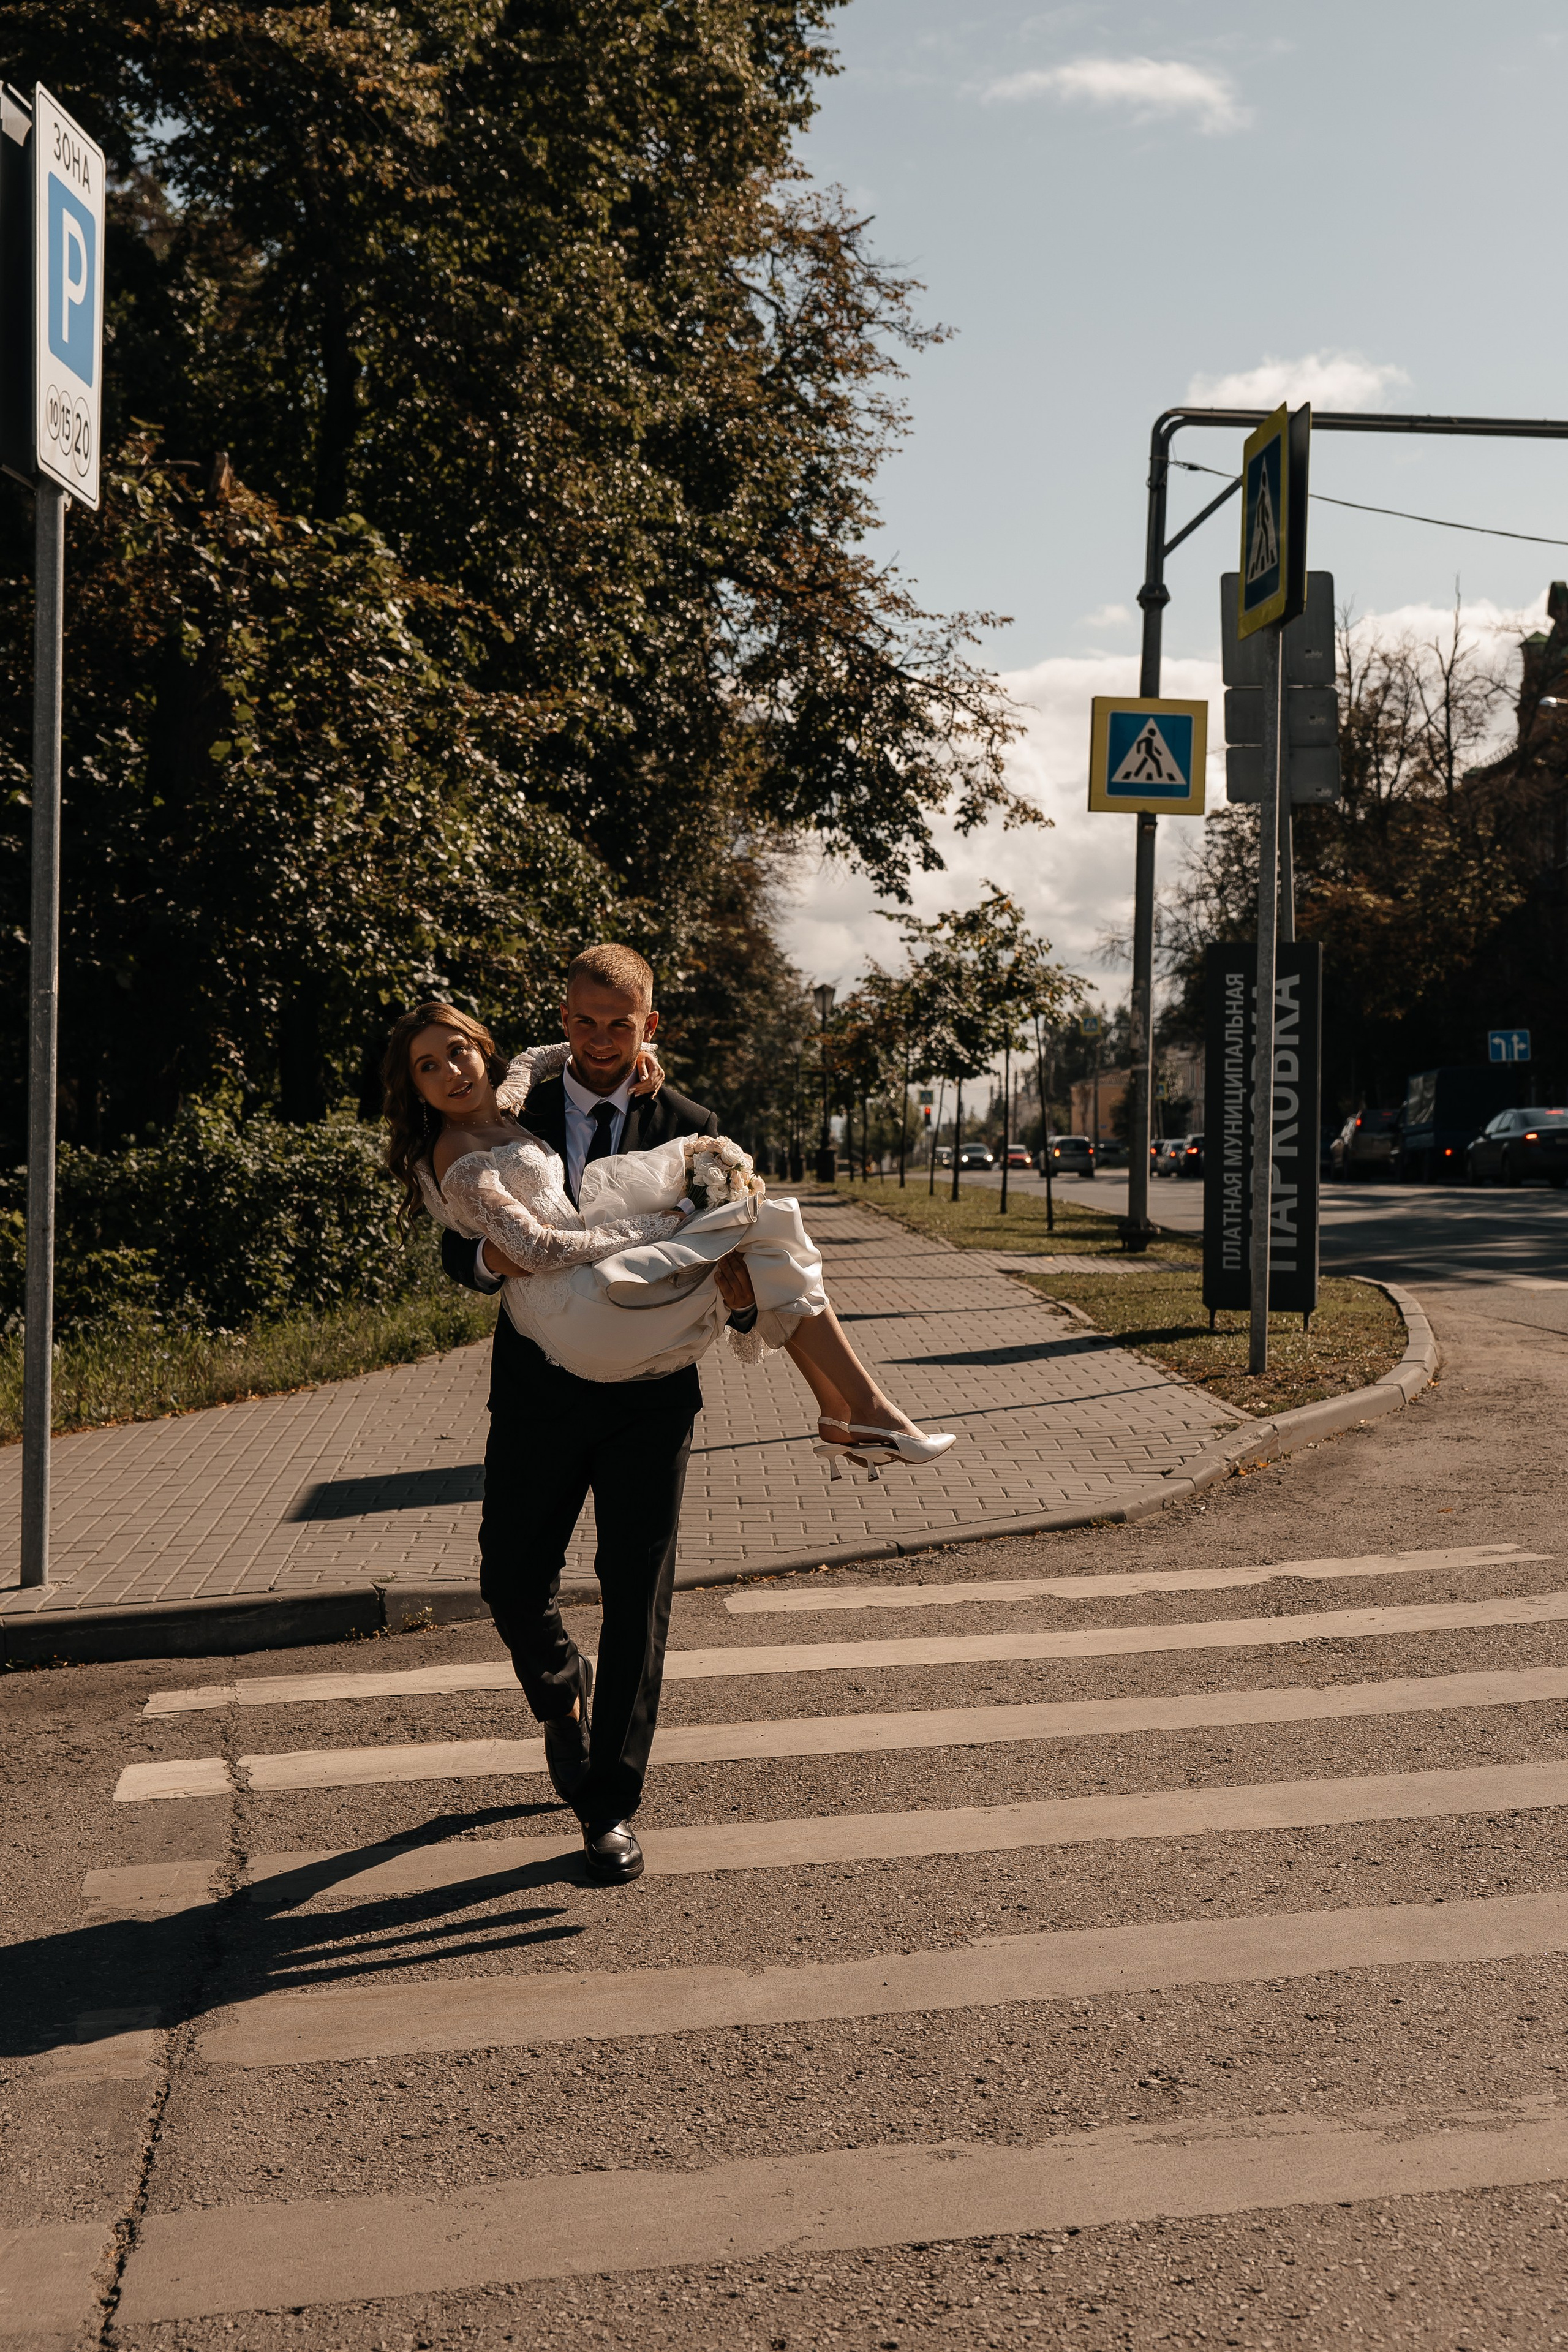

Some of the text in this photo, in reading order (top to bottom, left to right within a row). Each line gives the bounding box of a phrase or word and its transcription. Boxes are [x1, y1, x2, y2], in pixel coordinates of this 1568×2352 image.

[54, 122, 91, 194] ЗОНА
[62, 206, 88, 344] P
[49, 398, 89, 460] 10 15 20
[1223, 973, 1246, 1270] ПЛАТНАЯ МУНИЦИПАЛЬНАЯ
[1250, 974, 1300, 1272] ПАРКОВКА
